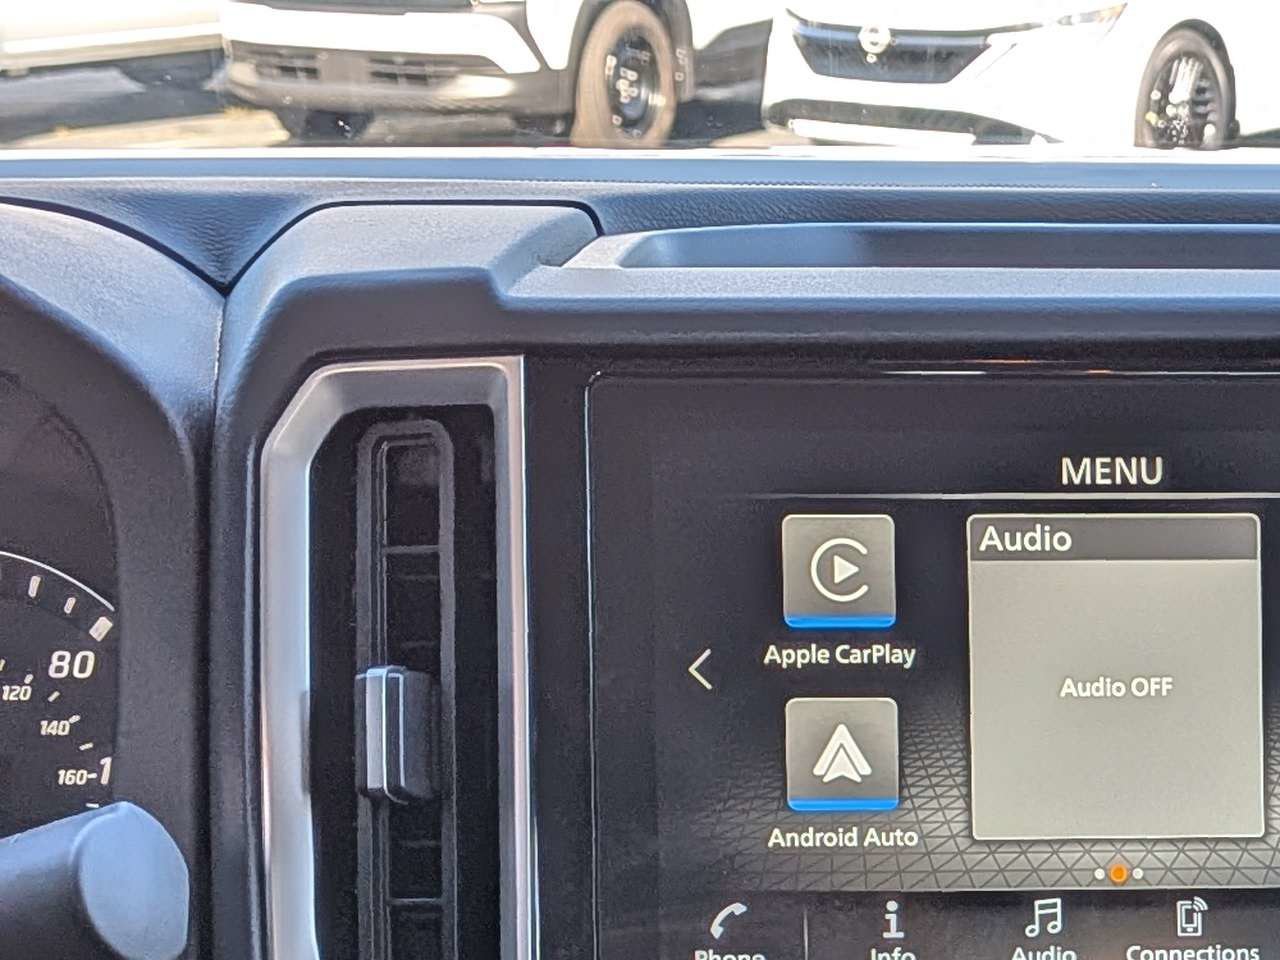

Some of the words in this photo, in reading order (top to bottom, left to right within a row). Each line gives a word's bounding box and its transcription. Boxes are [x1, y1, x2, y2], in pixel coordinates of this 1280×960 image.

[1061, 458, 1163, 486] MENU
[979, 524, 1072, 552] Audio
[48, 650, 95, 679] 80
[764, 645, 830, 669] Apple
[834, 644, 916, 669] CarPlay
[2, 685, 32, 701] 120
[1060, 677, 1127, 699] Audio
[1131, 676, 1173, 697] OFF
[40, 720, 70, 735] 140
[58, 769, 88, 785] 160
[768, 828, 858, 849] Android
[863, 828, 918, 848] Auto
